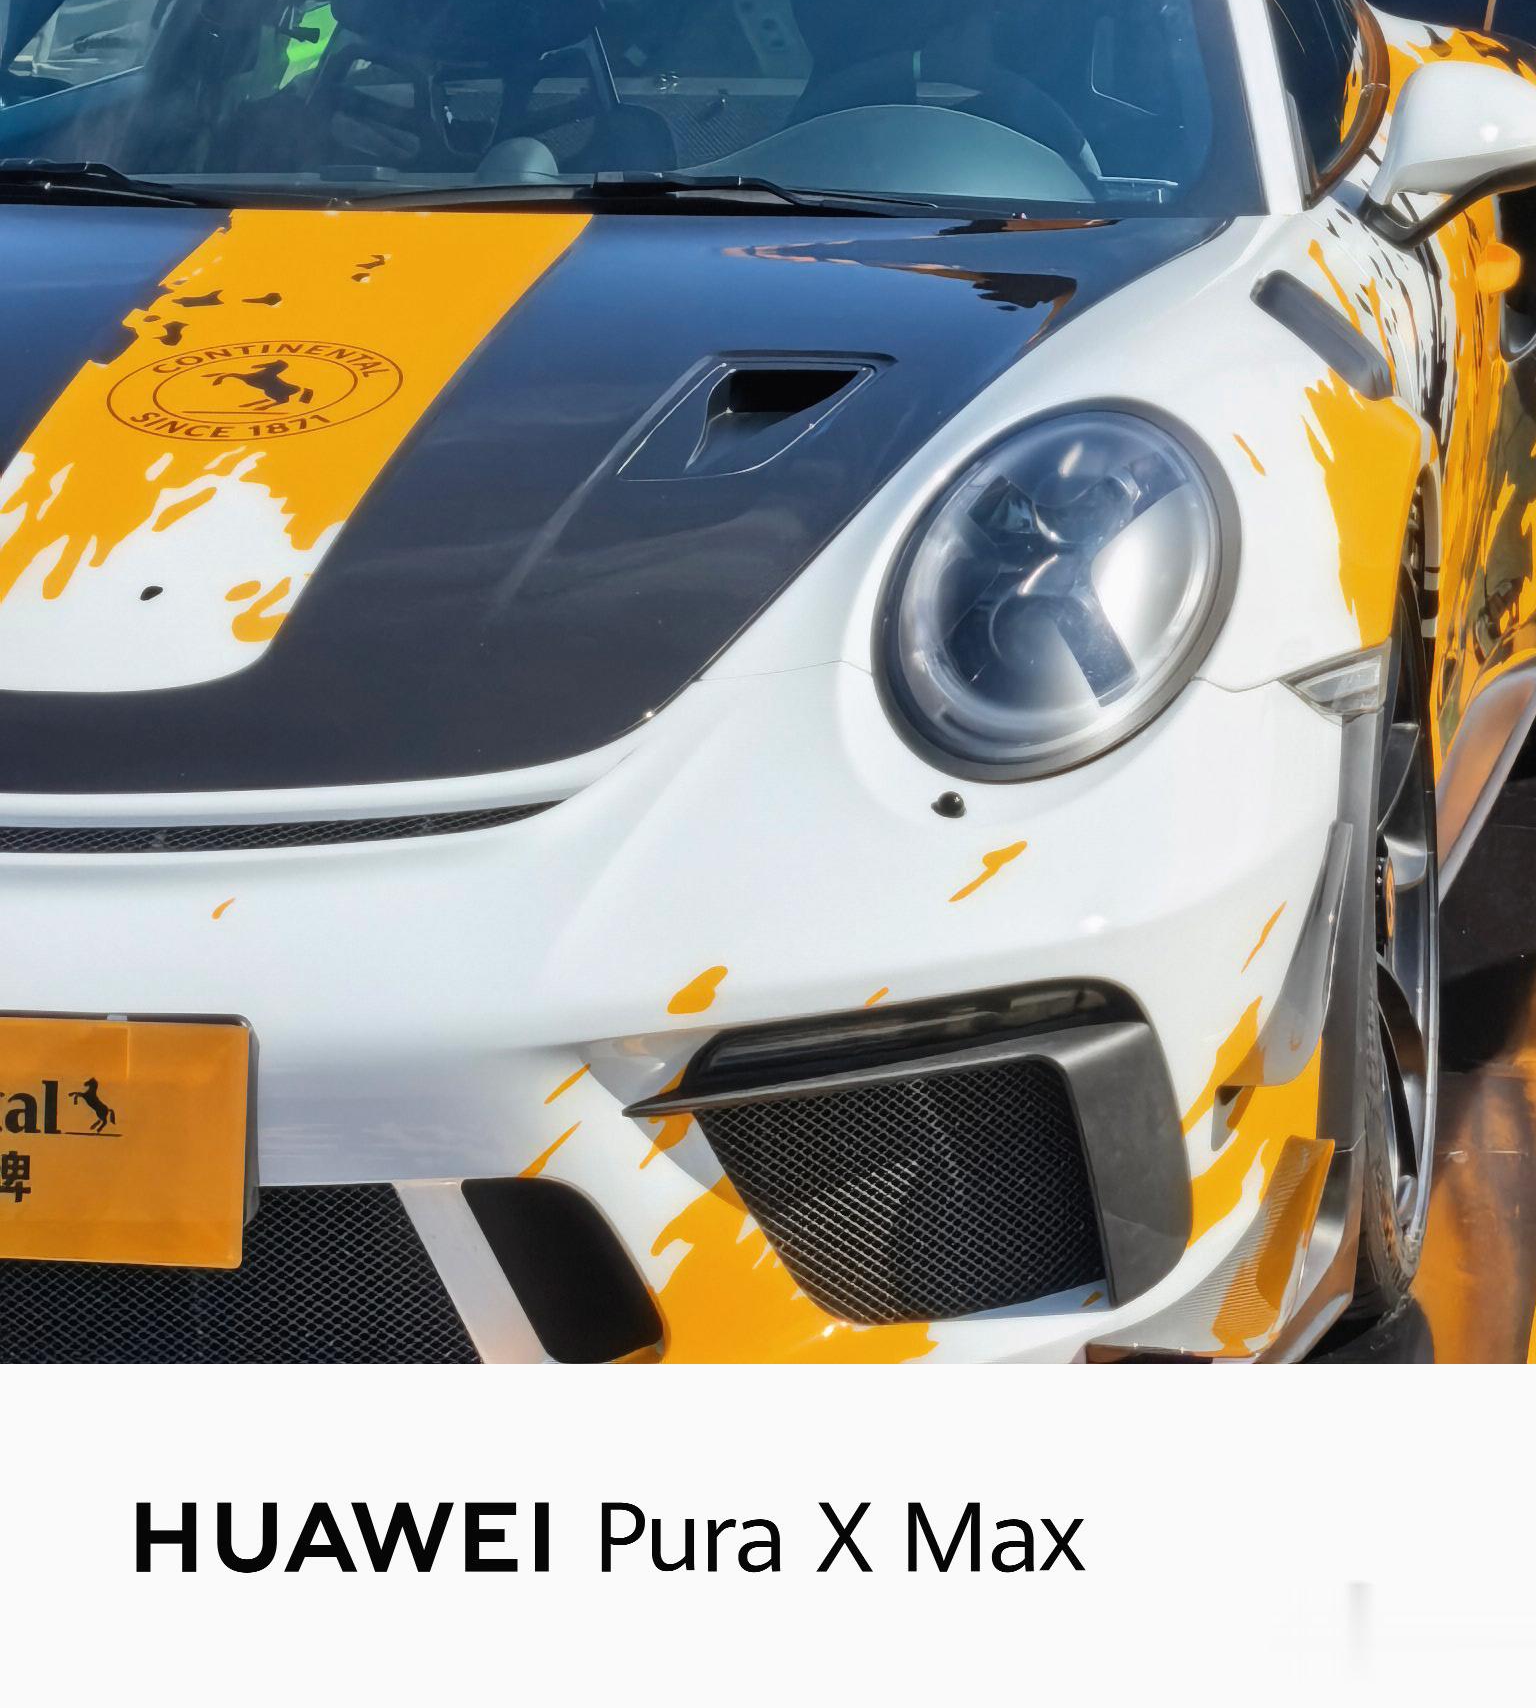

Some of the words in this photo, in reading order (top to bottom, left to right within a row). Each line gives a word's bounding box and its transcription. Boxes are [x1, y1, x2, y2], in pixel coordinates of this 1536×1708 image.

[153, 343, 392, 378] CONTINENTAL
[130, 411, 235, 439] SINCE
[248, 414, 331, 437] 1871
[0, 1079, 62, 1135] al
